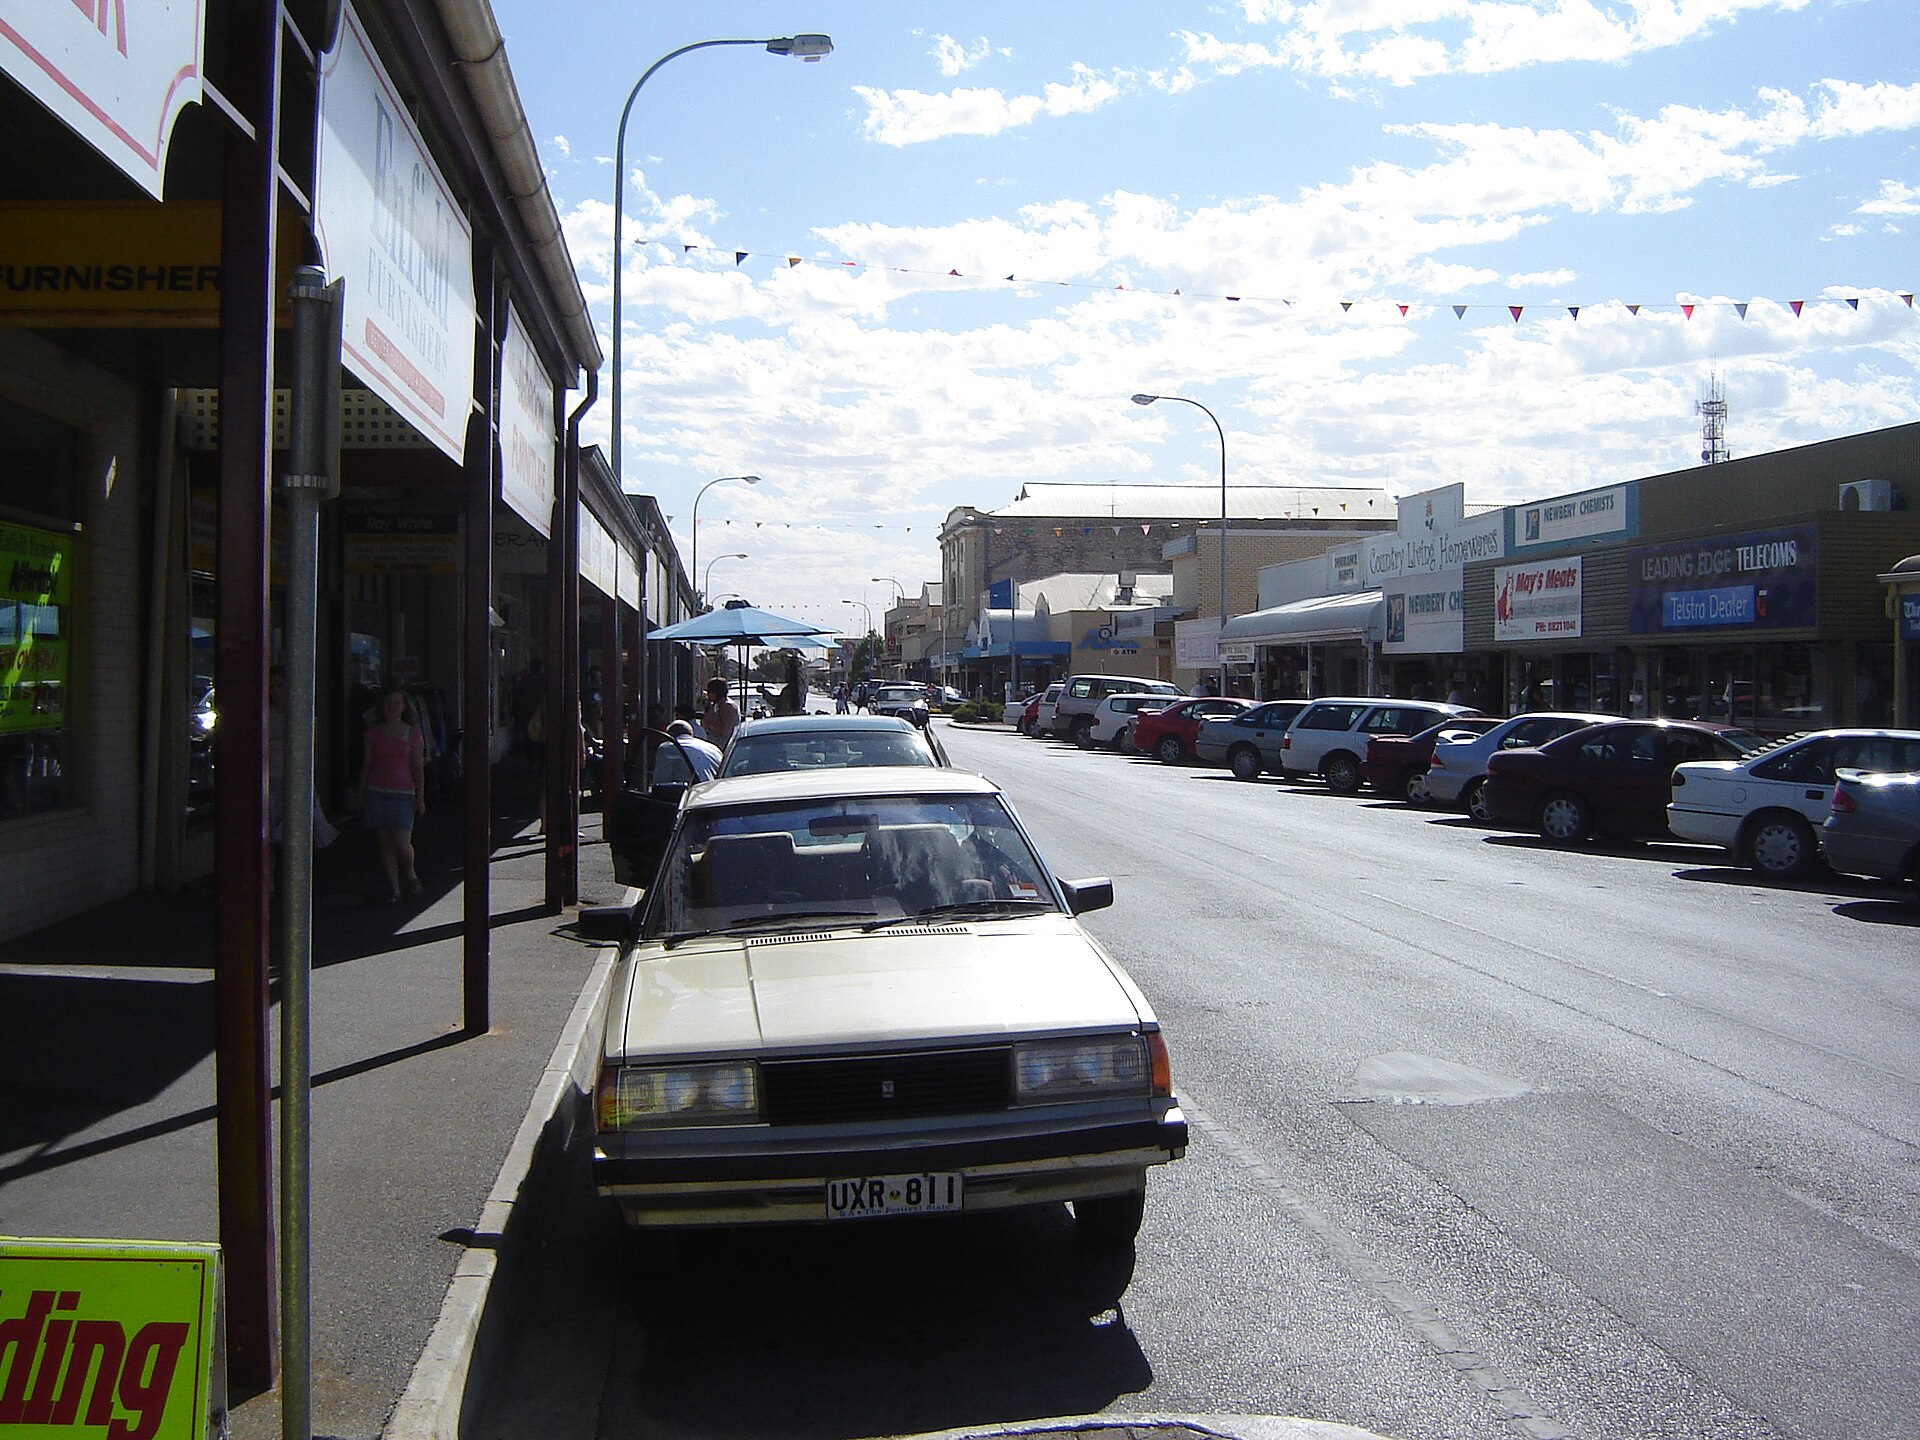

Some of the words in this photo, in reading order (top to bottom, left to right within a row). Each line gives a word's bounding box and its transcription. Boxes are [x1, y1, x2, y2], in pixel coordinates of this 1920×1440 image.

[366, 246, 449, 380] FURNISHERS
[366, 516, 392, 531] Ray
[397, 517, 432, 529] White
[1543, 502, 1577, 524] NEWBERY
[1579, 494, 1614, 515] CHEMISTS
[1369, 547, 1404, 576] Country
[1407, 539, 1435, 571] Living
[1439, 529, 1498, 571] Homewares
[1641, 553, 1692, 580] LEADING
[1696, 549, 1731, 576] EDGE
[1736, 540, 1797, 571] TELECOMS
[1515, 572, 1543, 595] May's
[1546, 567, 1577, 590] Meats
[1408, 592, 1446, 614] NEWBERY
[1670, 597, 1705, 620] Telstra
[1709, 593, 1748, 618] Dealer
[831, 1180, 885, 1211] UXR
[906, 1175, 954, 1206] 811
